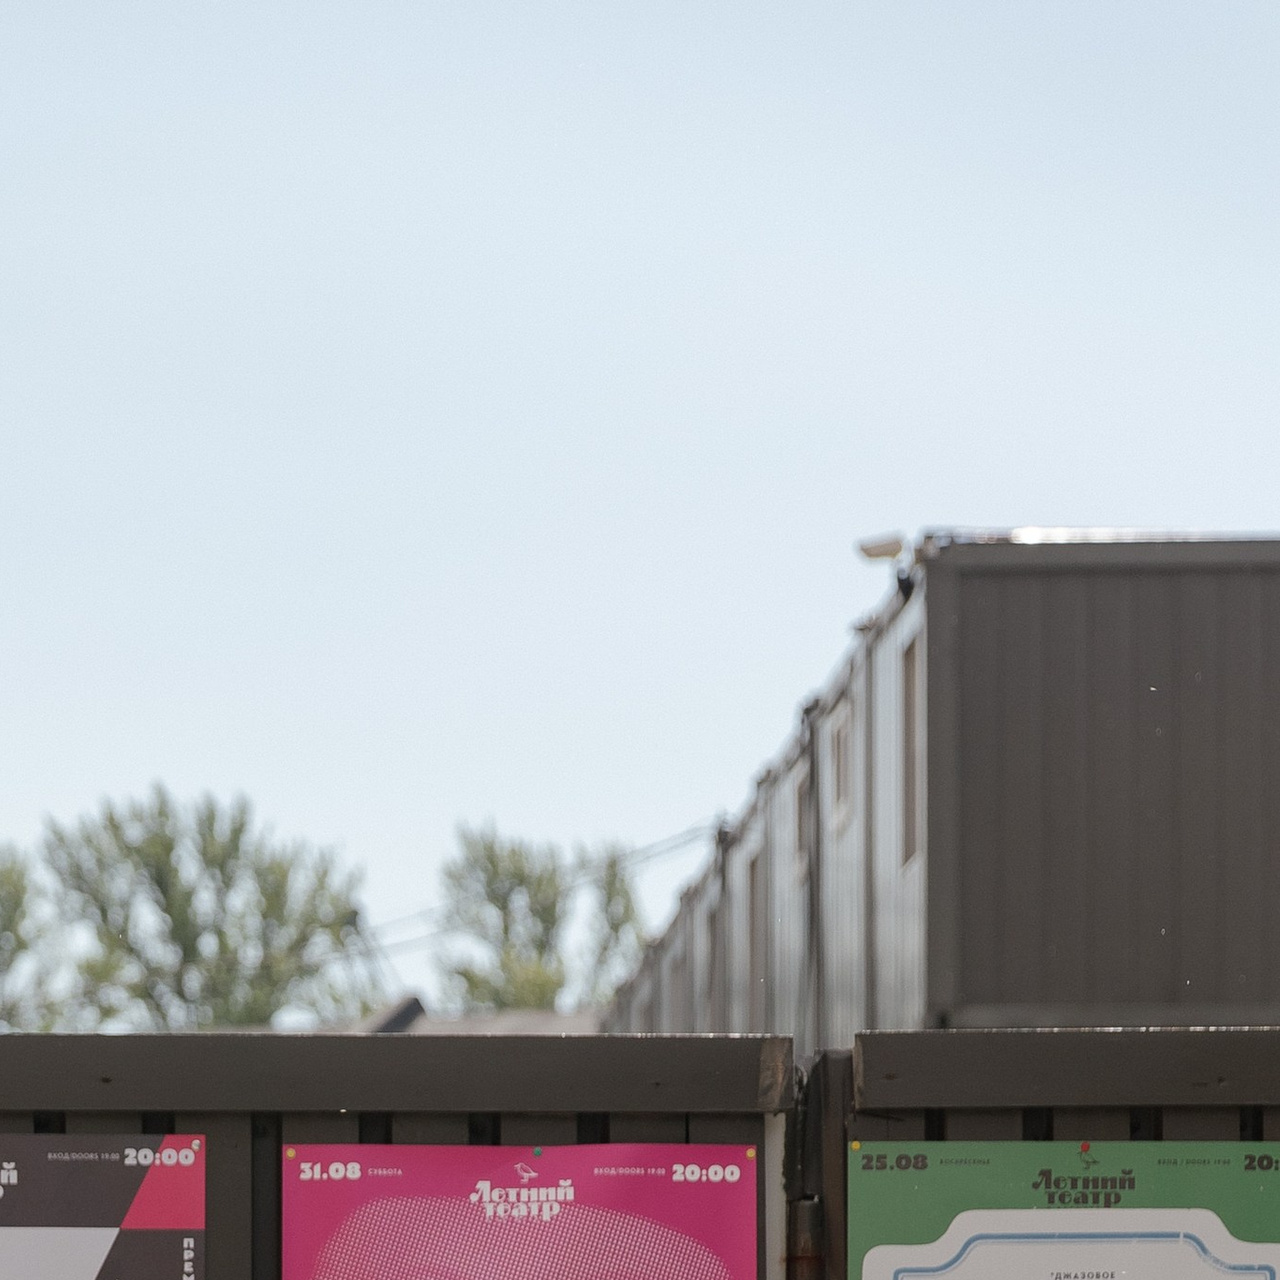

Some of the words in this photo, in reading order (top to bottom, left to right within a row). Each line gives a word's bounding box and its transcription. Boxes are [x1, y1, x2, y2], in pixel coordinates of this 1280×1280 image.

[124, 1147, 195, 1167] 20:00
[861, 1153, 928, 1171] 25.08
[299, 1162, 362, 1181] 31.08
[672, 1164, 741, 1182] 20:00
[1031, 1168, 1136, 1190] Летний
[469, 1179, 575, 1202] Летний
[1045, 1190, 1122, 1208] театр
[484, 1201, 561, 1221] театр
